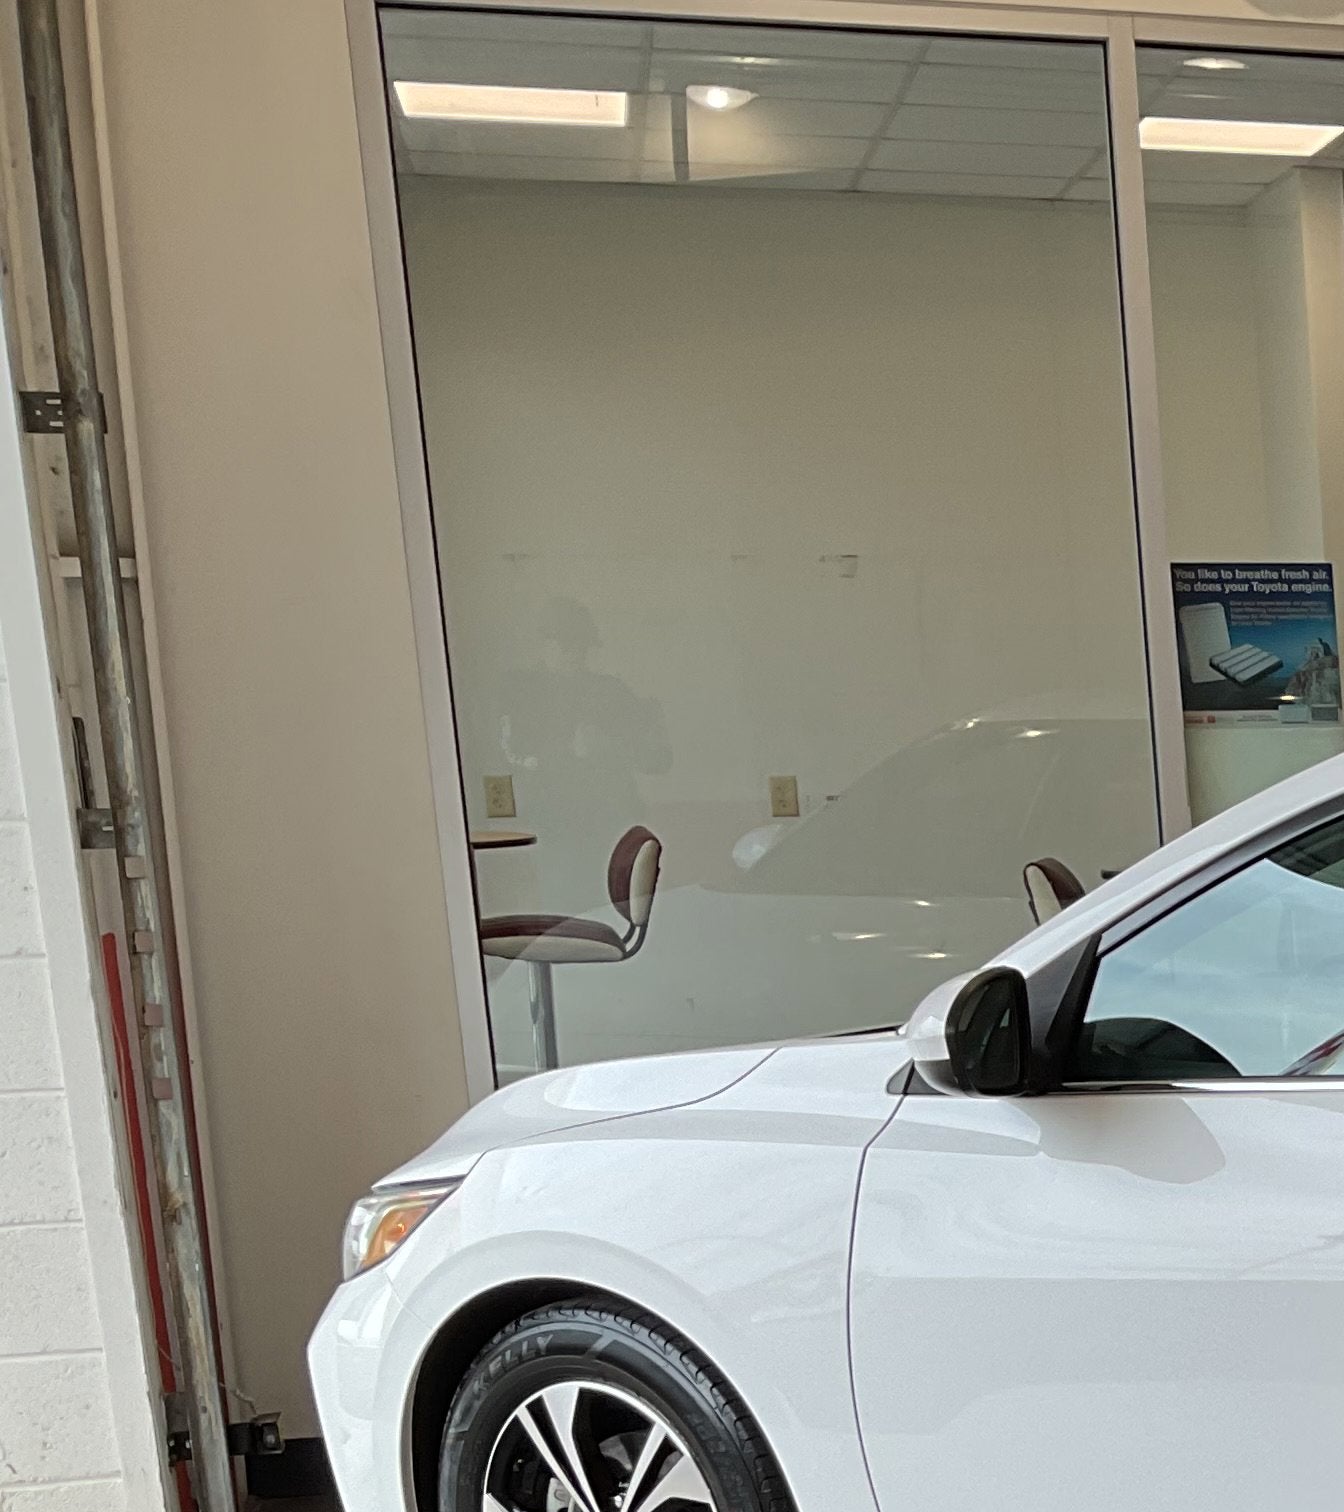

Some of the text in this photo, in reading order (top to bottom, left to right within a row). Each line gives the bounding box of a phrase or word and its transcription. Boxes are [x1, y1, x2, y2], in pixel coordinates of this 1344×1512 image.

[1174, 568, 1330, 580] You like to breathe fresh air.
[1175, 581, 1333, 594] So does your Toyota engine.
[472, 1333, 555, 1397] KELLY
